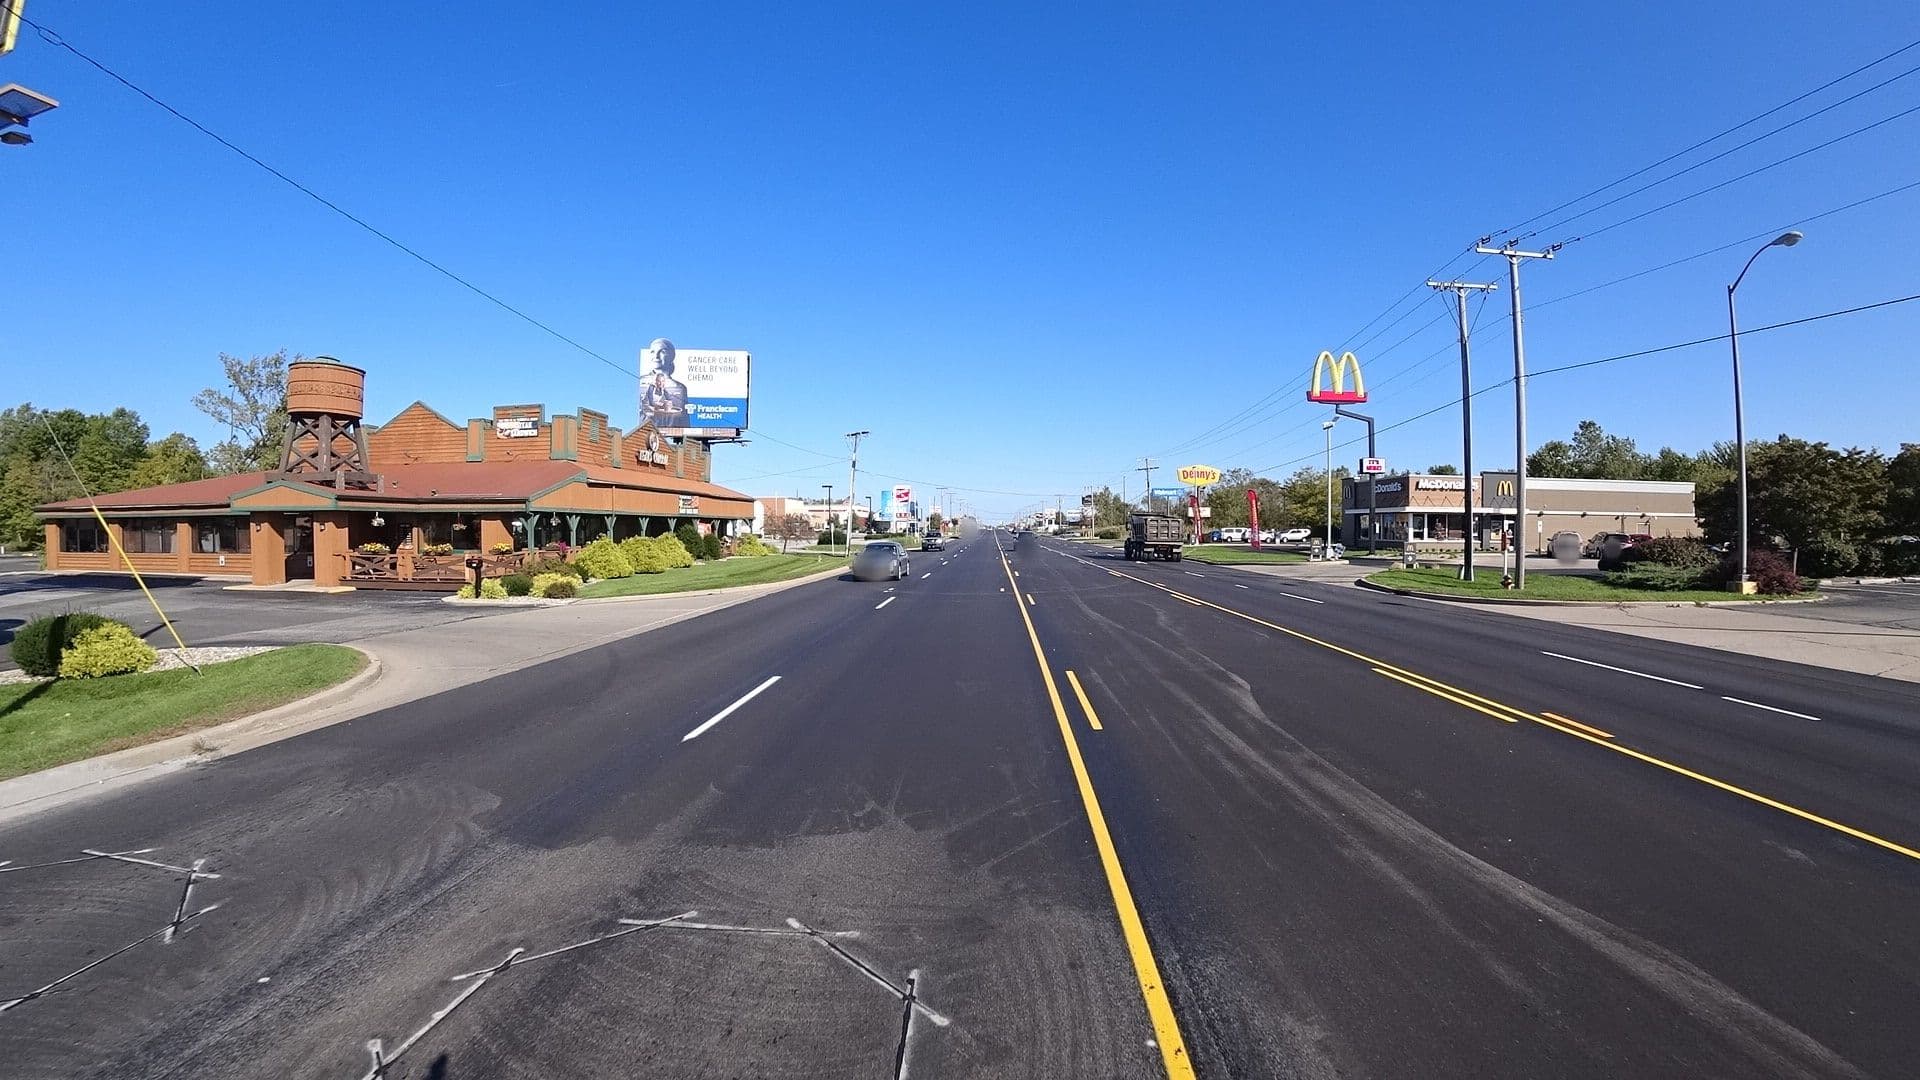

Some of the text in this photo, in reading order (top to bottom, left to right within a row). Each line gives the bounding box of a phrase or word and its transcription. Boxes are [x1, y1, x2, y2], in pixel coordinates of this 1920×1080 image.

[687, 355, 737, 365] CANCER CARE
[687, 365, 739, 374] WELL BEYOND
[687, 374, 714, 382] CHEMO
[697, 403, 739, 413] Franciscan
[1182, 469, 1217, 481] Denny's
[1374, 482, 1402, 493] cDonald's
[1418, 479, 1480, 491] McDonal's
